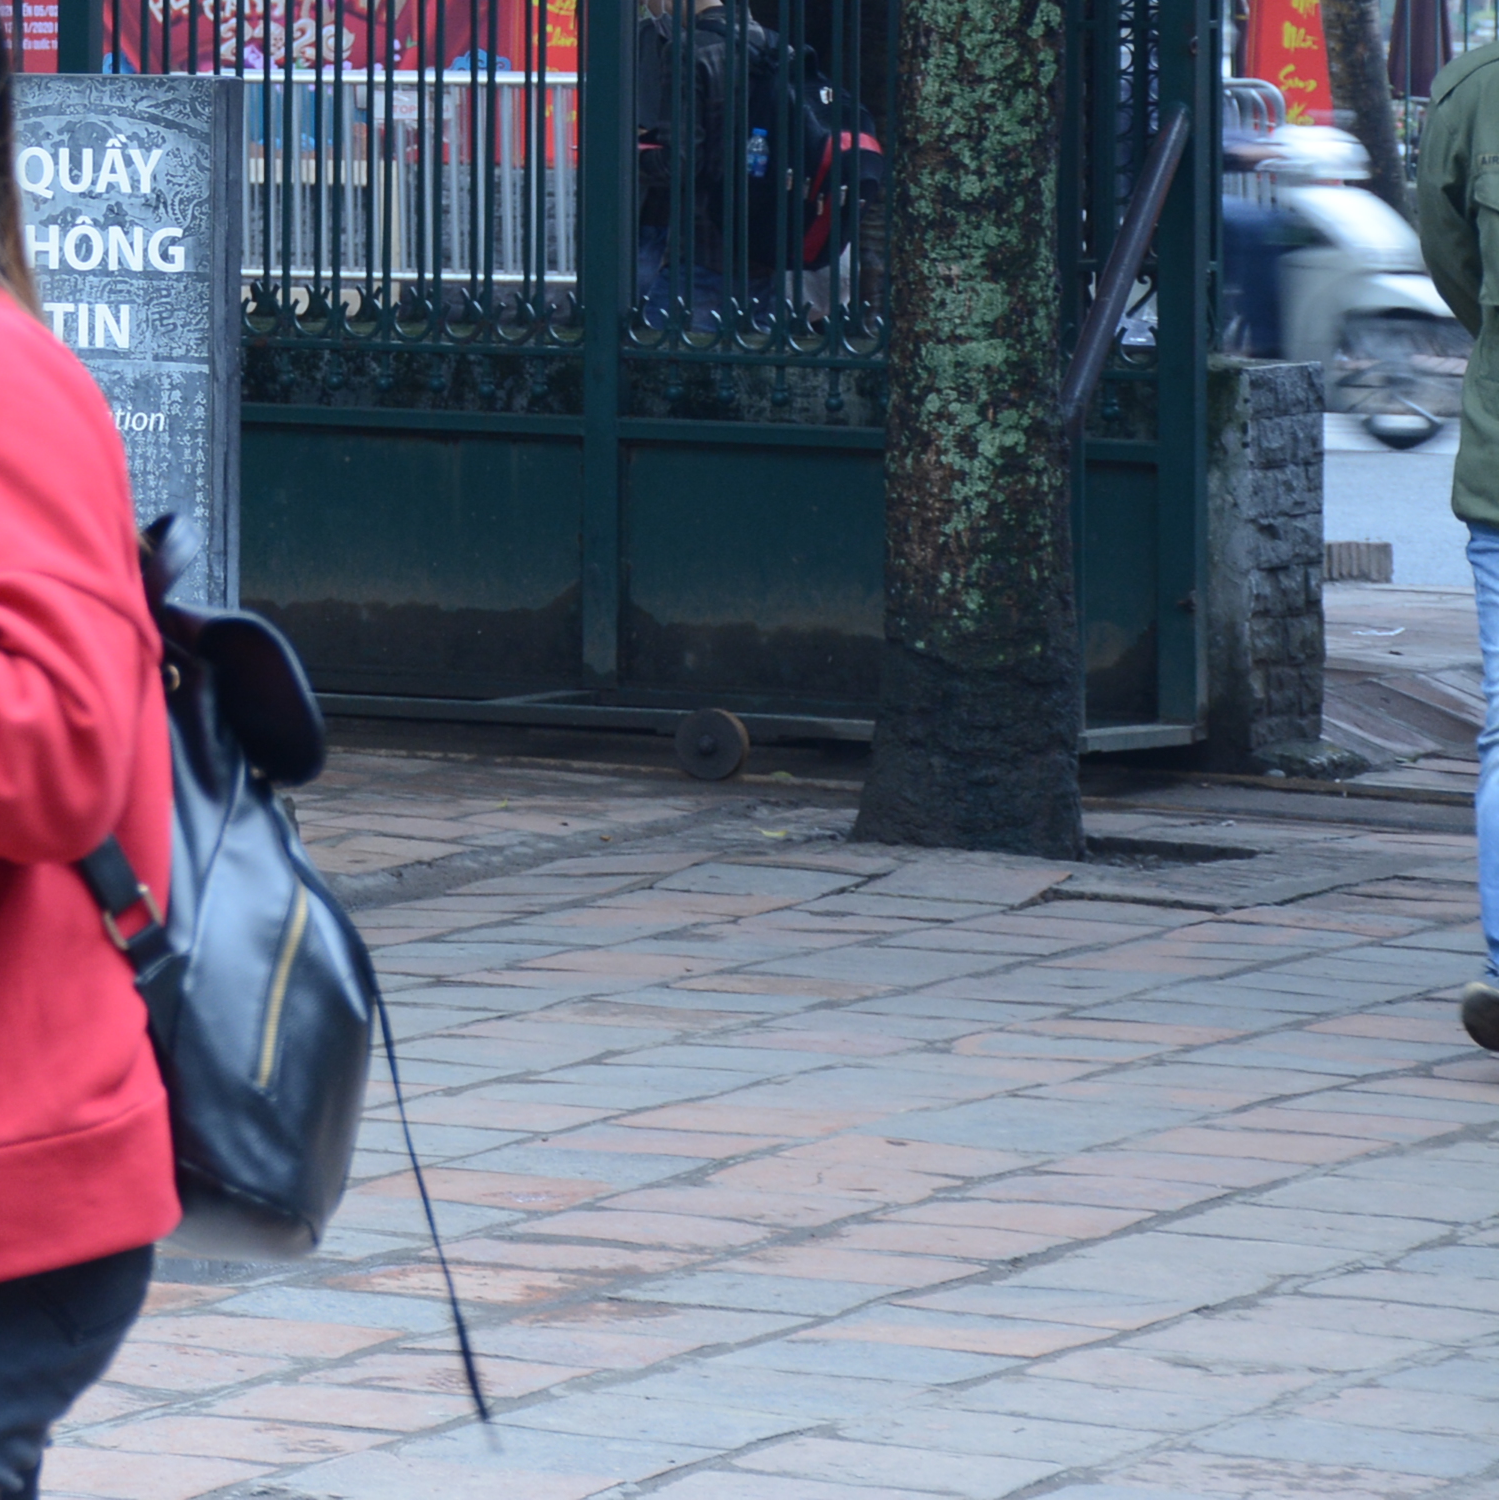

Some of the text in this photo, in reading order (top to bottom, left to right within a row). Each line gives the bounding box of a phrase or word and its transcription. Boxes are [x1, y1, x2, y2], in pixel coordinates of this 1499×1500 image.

[16, 134, 163, 199] QUẦY
[25, 216, 185, 272] HÔNG
[43, 303, 130, 349] TIN
[112, 410, 166, 432] tion
